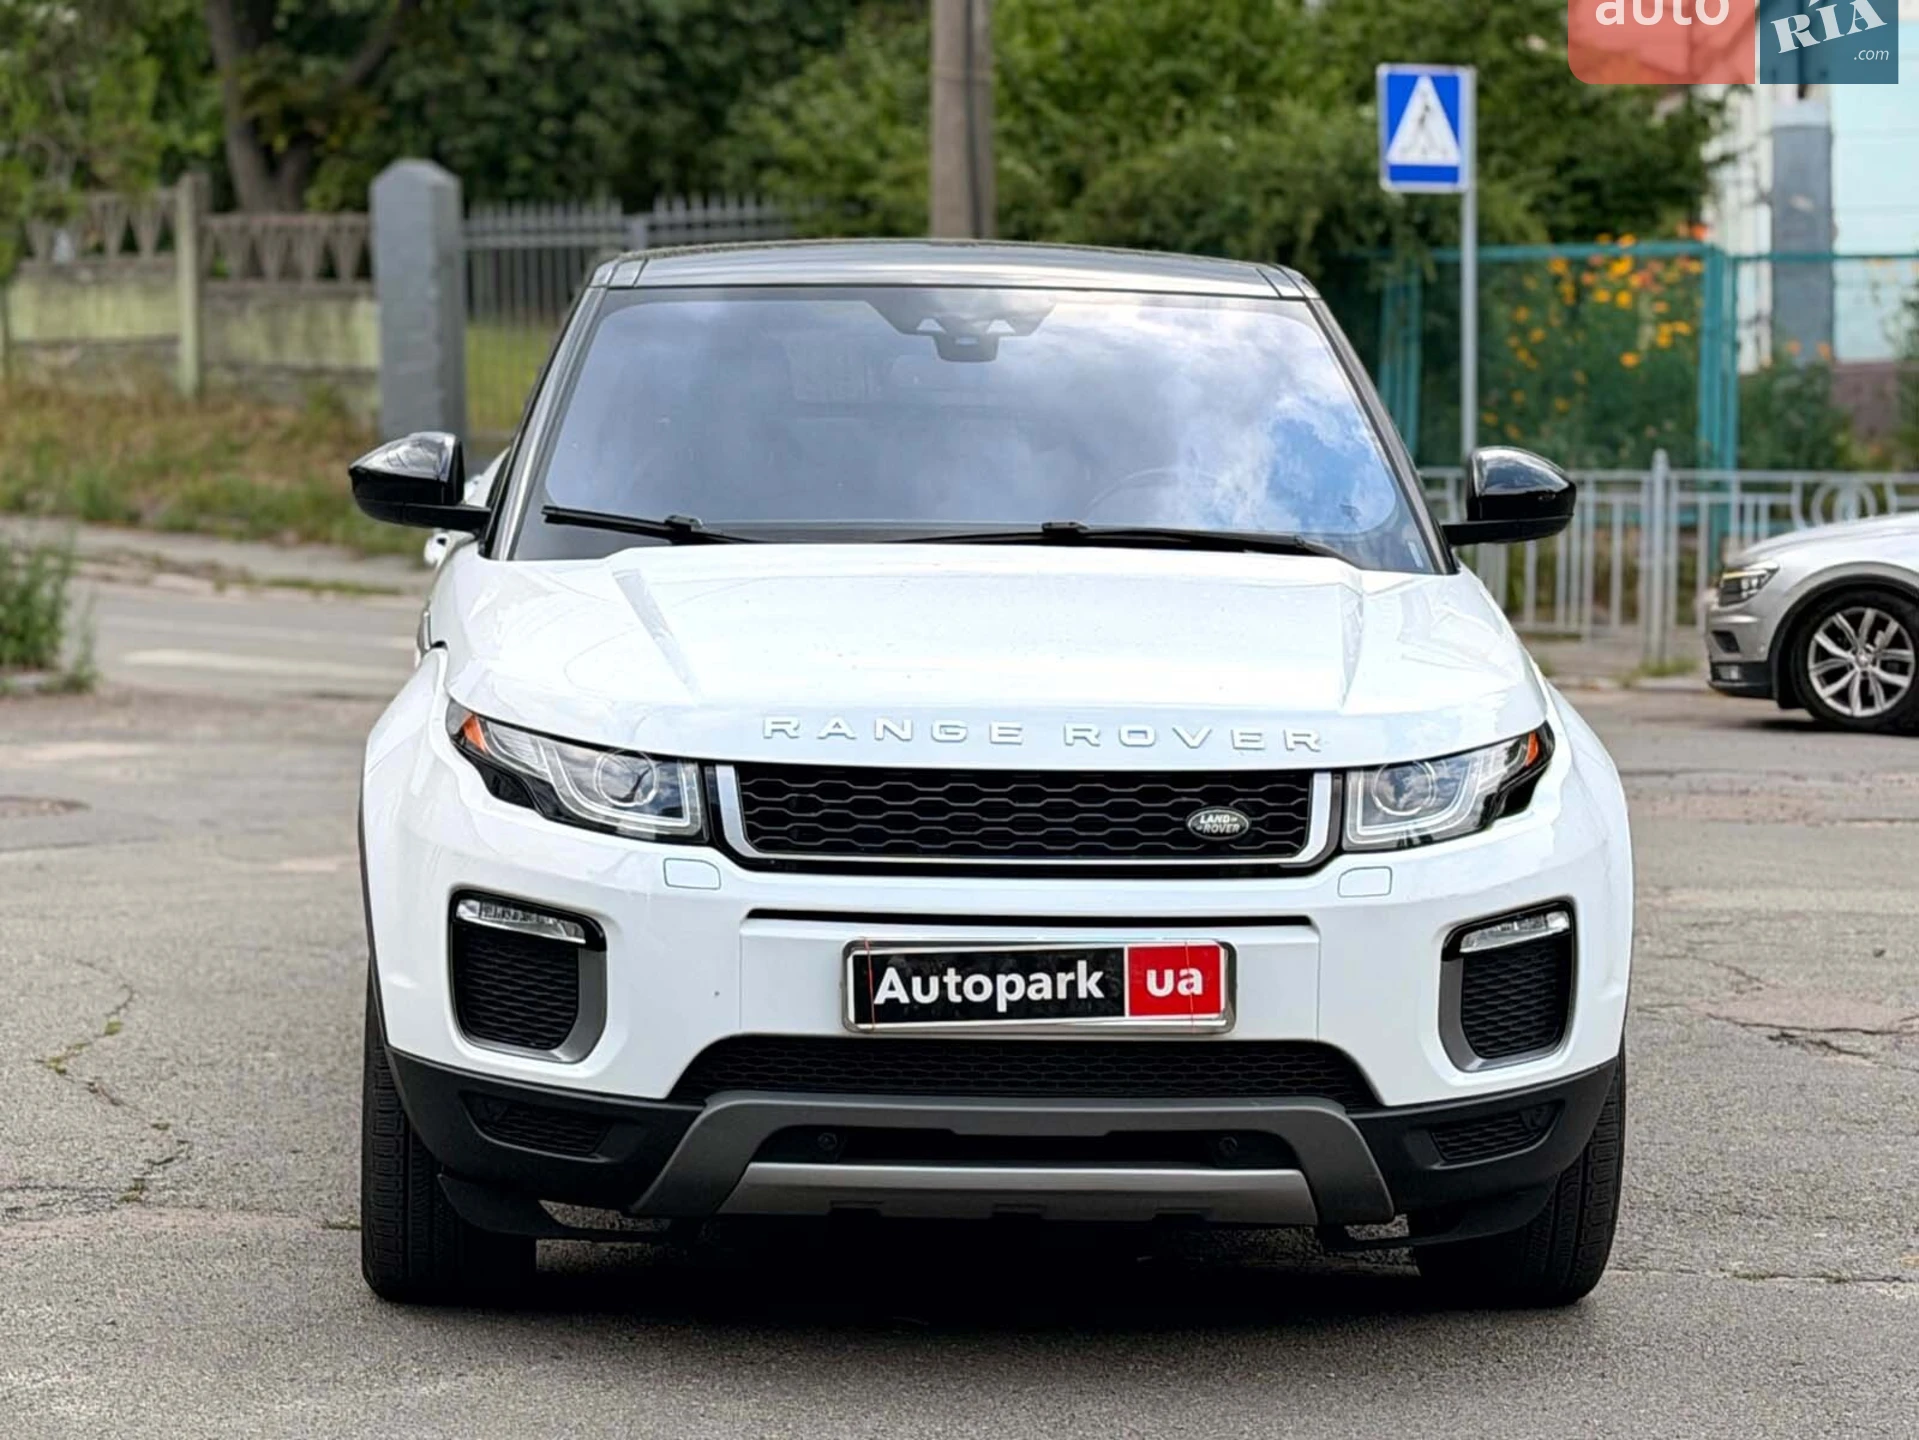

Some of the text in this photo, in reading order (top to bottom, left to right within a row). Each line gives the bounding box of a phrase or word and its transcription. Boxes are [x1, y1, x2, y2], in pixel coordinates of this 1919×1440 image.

[762, 716, 1323, 752] RANGE ROVER
[1203, 823, 1241, 834] ROVER
[873, 960, 1204, 1013] Autopark ua
